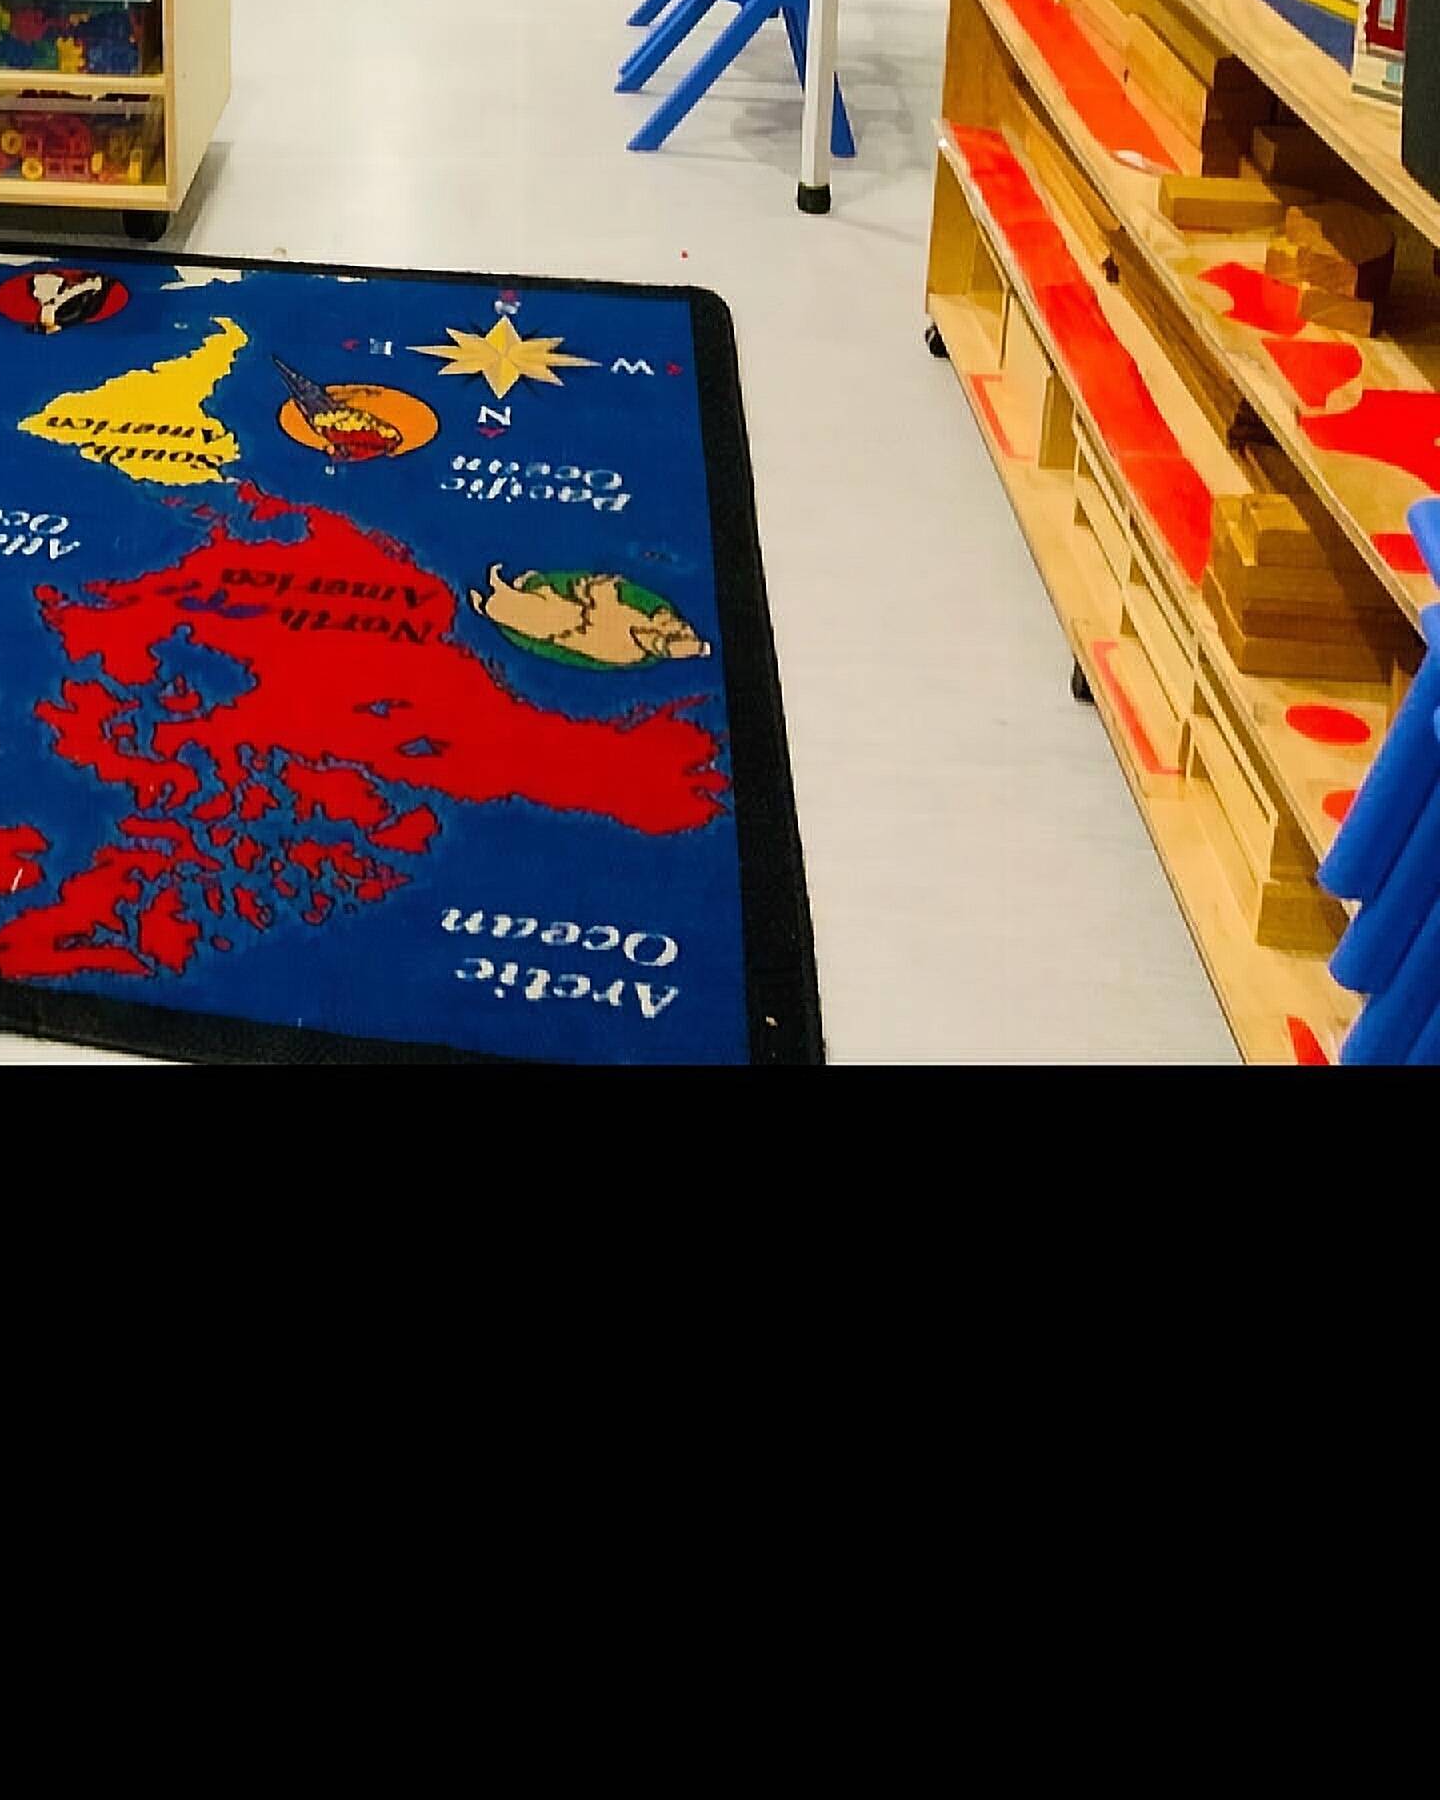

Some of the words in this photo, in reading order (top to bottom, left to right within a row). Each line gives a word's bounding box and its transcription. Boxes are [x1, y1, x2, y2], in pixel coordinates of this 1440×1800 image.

[610, 357, 655, 376] W
[45, 416, 225, 444] America
[477, 405, 511, 426] N
[220, 568, 440, 610] America
[279, 607, 433, 646] North
[440, 907, 679, 968] Ocean
[456, 957, 679, 1020] Arctic
